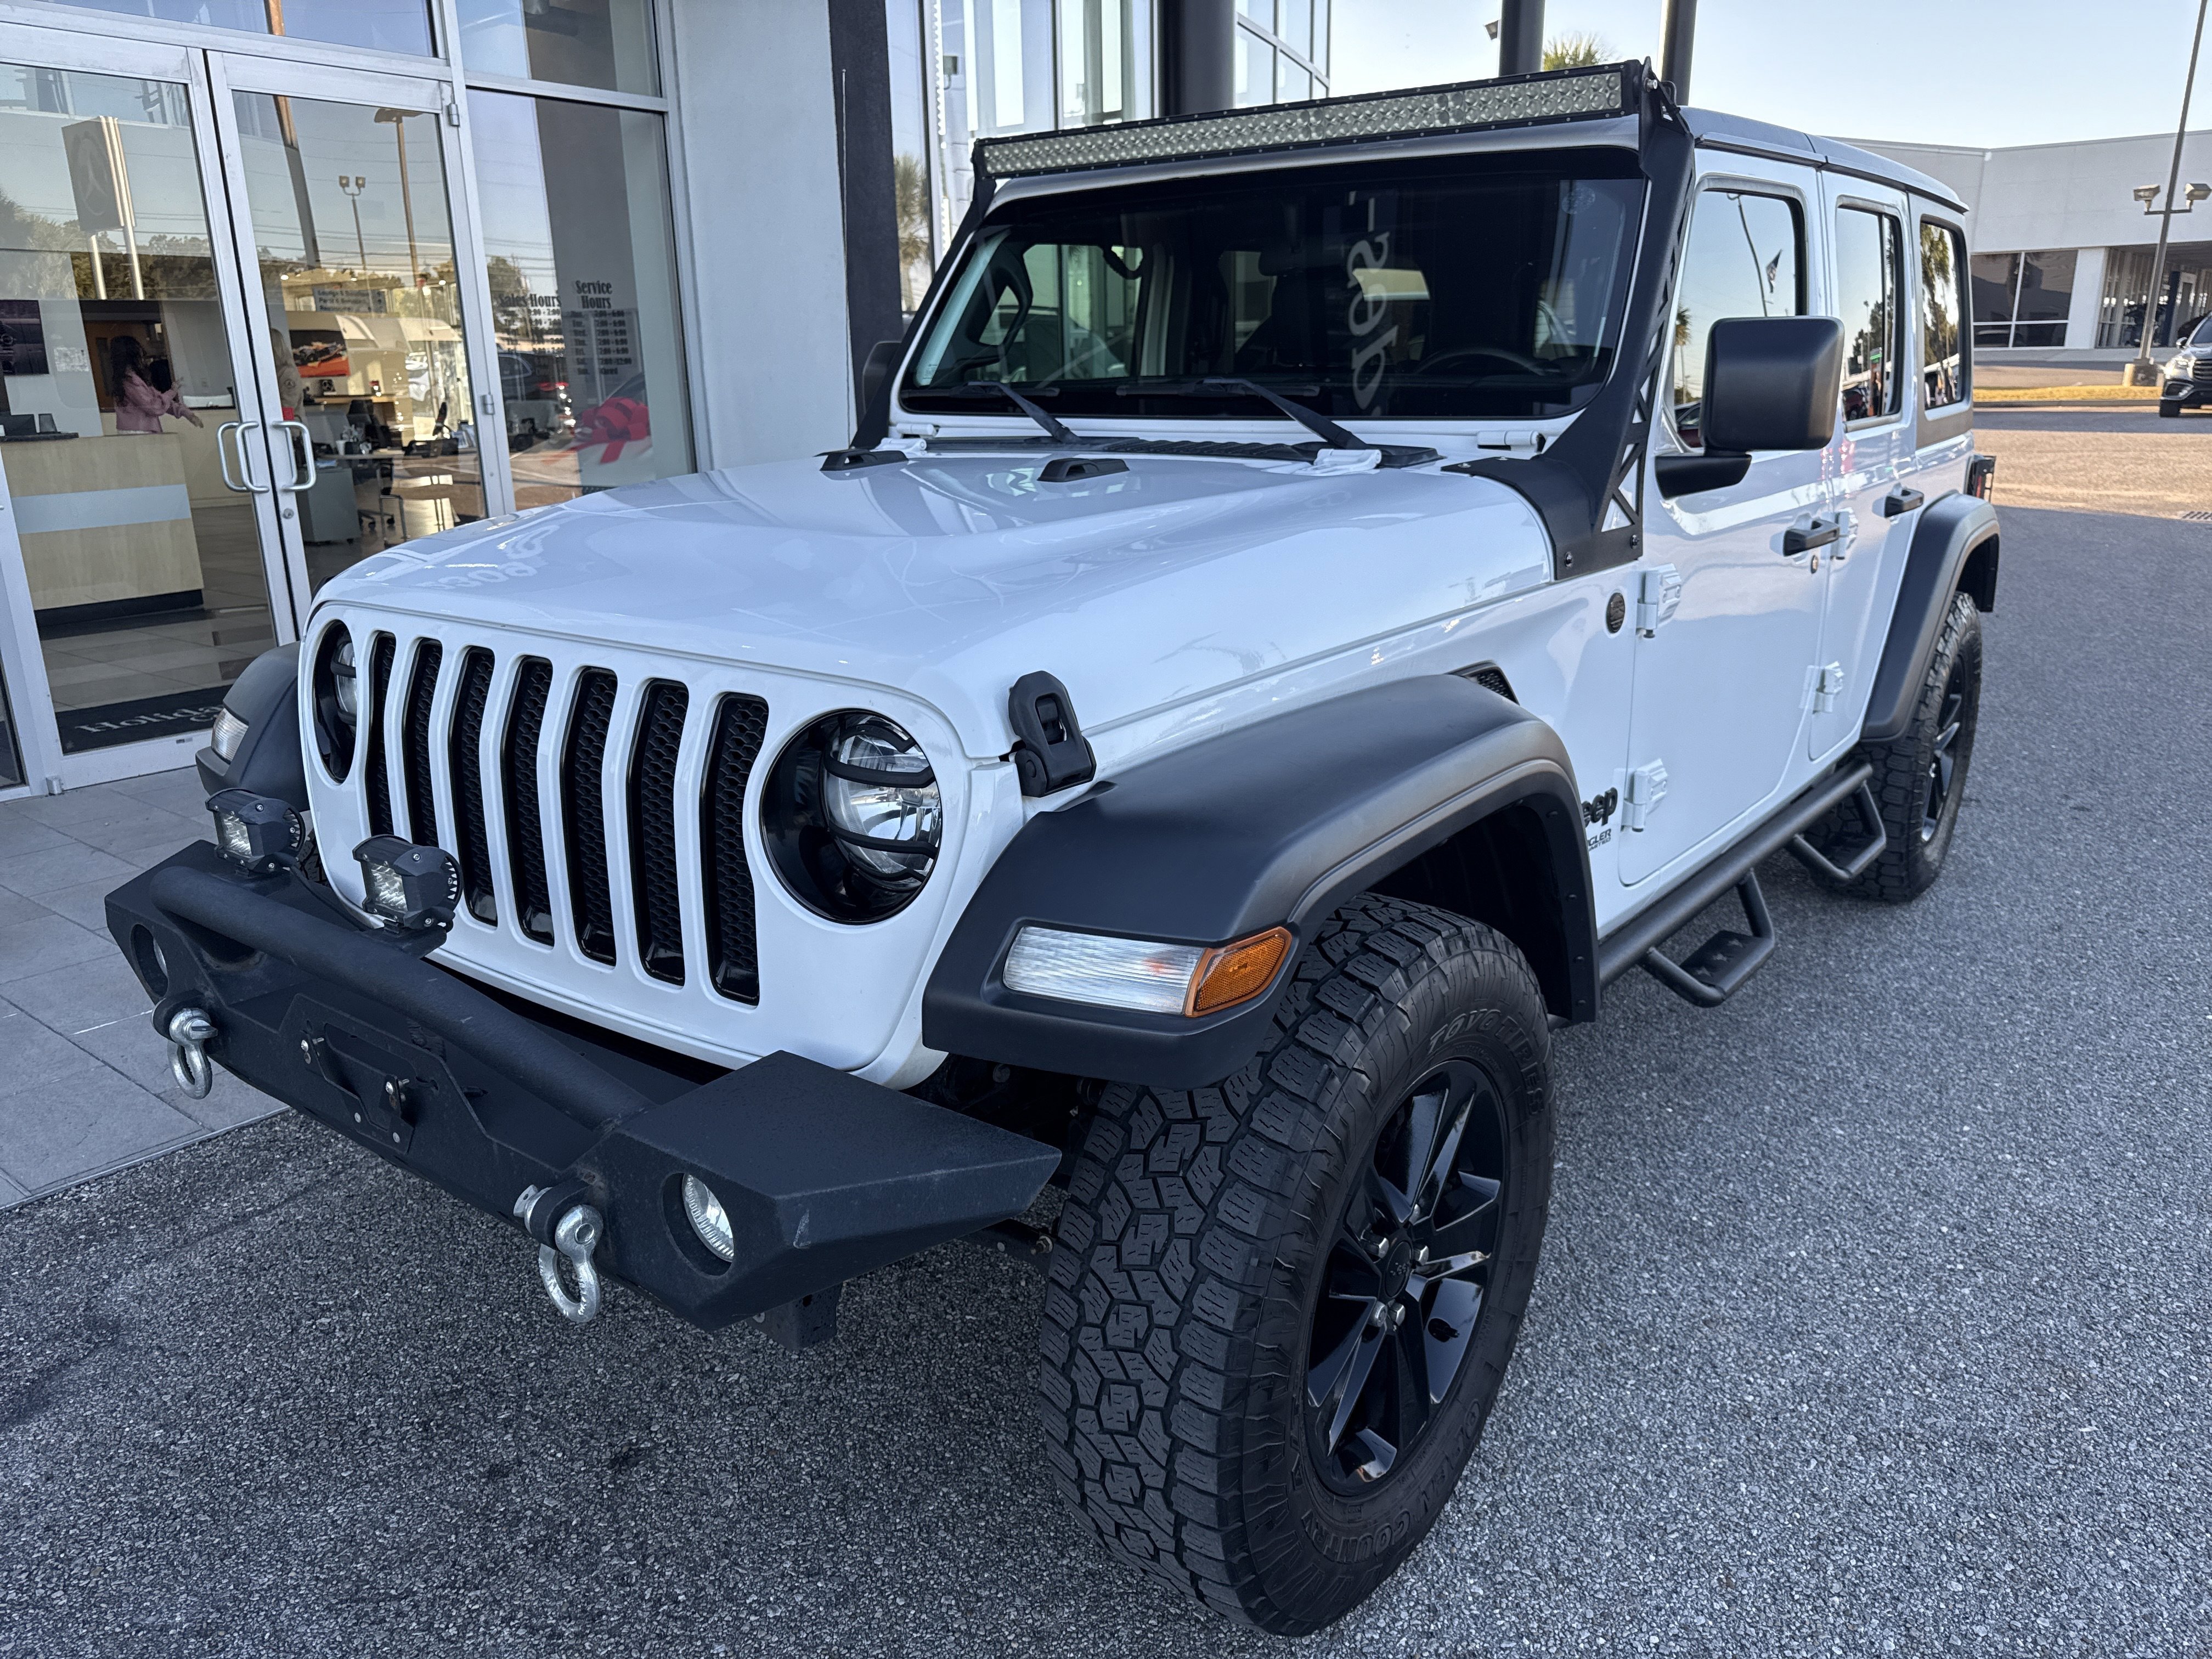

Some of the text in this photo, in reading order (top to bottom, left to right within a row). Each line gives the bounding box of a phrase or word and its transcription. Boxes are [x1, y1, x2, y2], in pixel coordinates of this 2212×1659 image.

[575, 280, 612, 294] Service
[530, 294, 562, 307] Hours
[581, 295, 612, 309] Hours
[74, 704, 224, 733] Holida
[1582, 787, 1618, 828] eep
[1587, 828, 1612, 847] GLER
[1427, 1008, 1545, 1115] TOYO TIRES
[1301, 1508, 1411, 1564] COUNTRY
